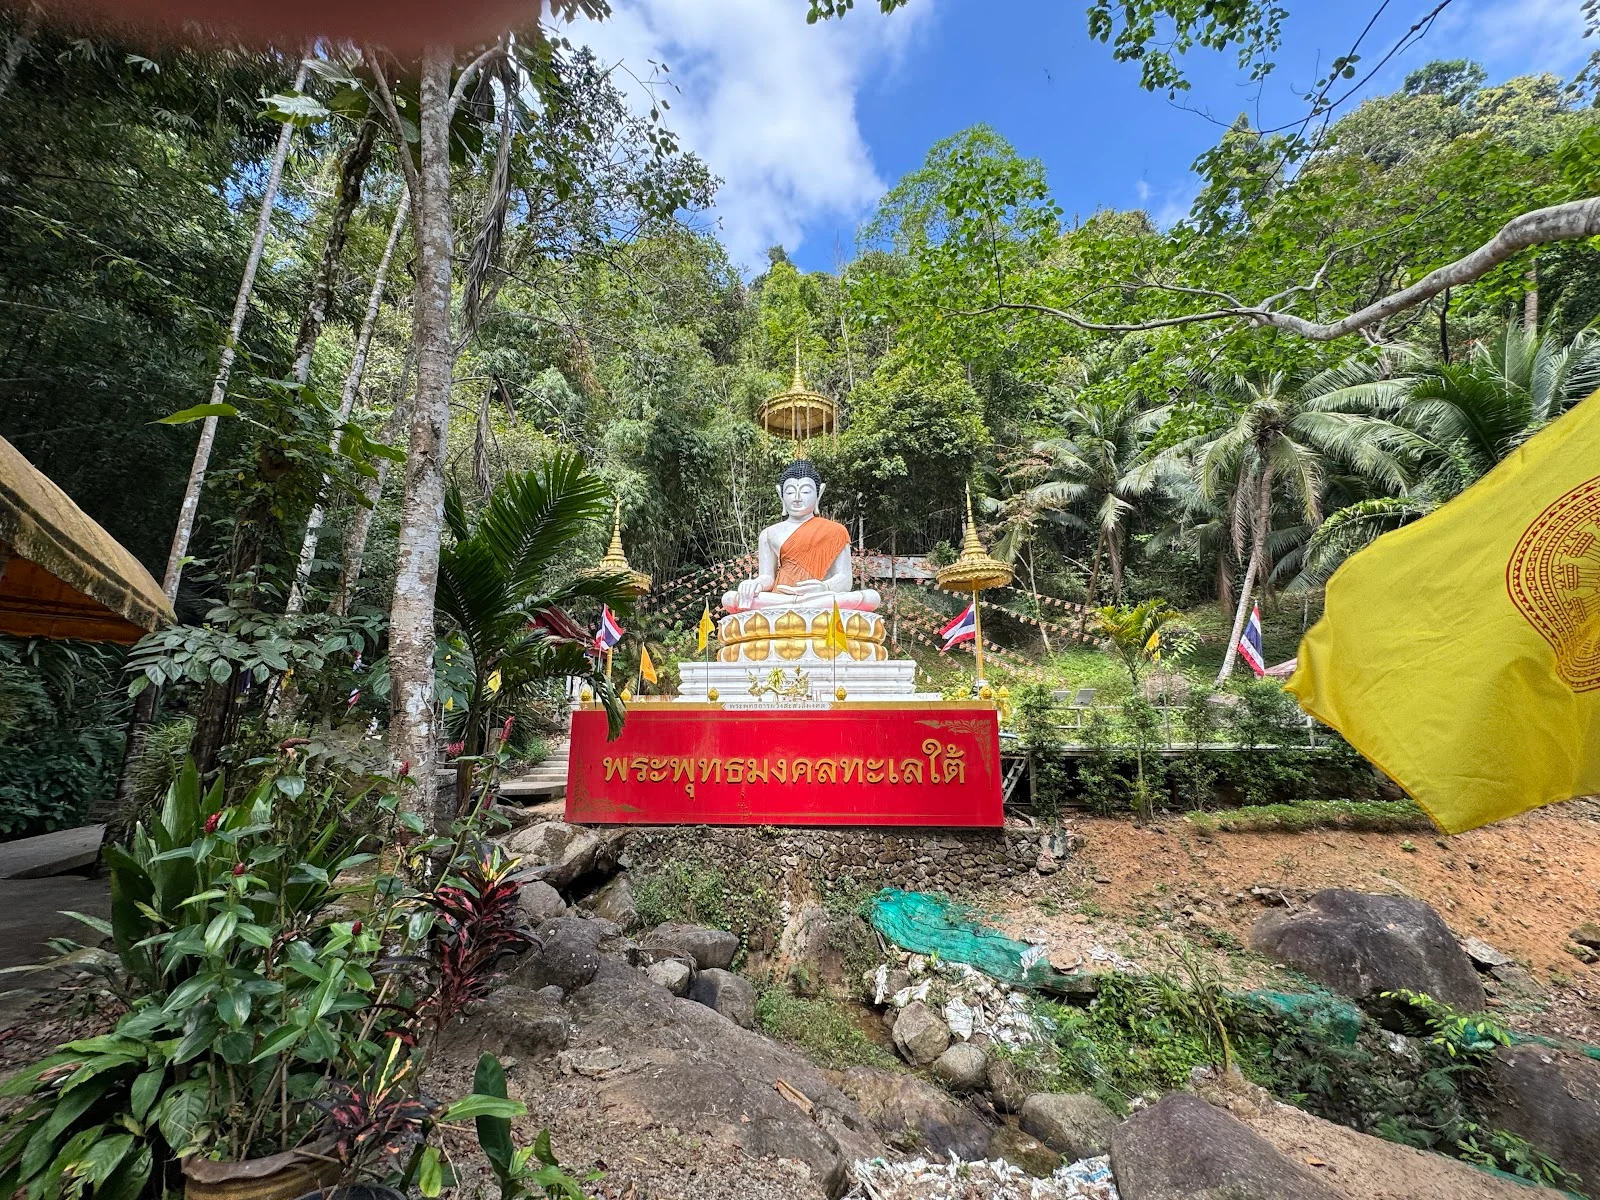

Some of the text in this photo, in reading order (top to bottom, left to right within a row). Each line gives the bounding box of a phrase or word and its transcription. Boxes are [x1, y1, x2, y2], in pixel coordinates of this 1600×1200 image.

[603, 738, 966, 799] พระพุทธมงคลทะเลใต้
